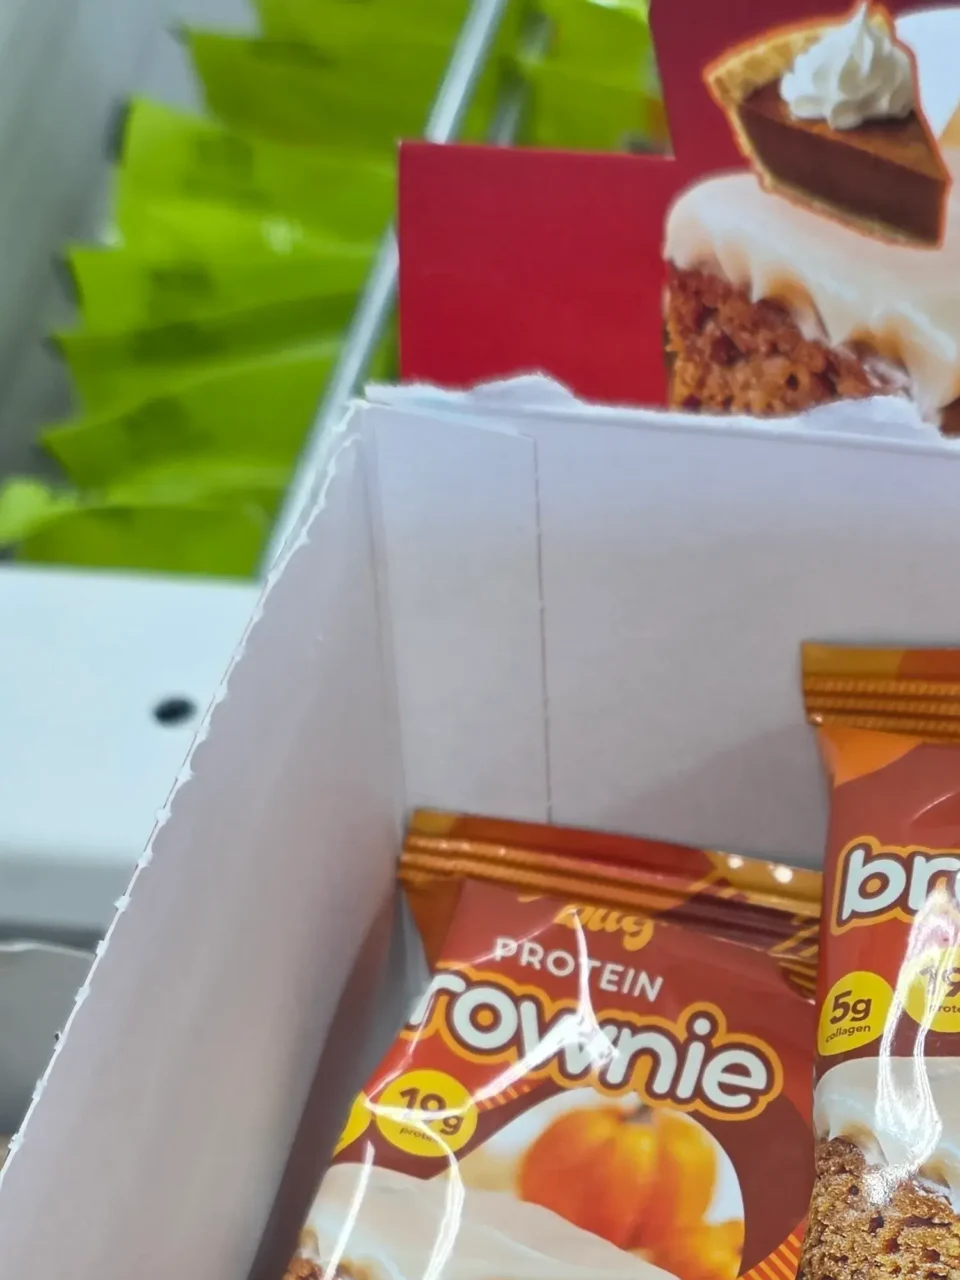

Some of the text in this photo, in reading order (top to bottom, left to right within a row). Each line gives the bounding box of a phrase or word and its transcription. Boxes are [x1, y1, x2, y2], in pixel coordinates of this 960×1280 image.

[493, 937, 664, 1003] PROTEIN
[825, 1023, 872, 1043] collagen
[829, 989, 872, 1026] 5g
[408, 974, 768, 1109] rownie
